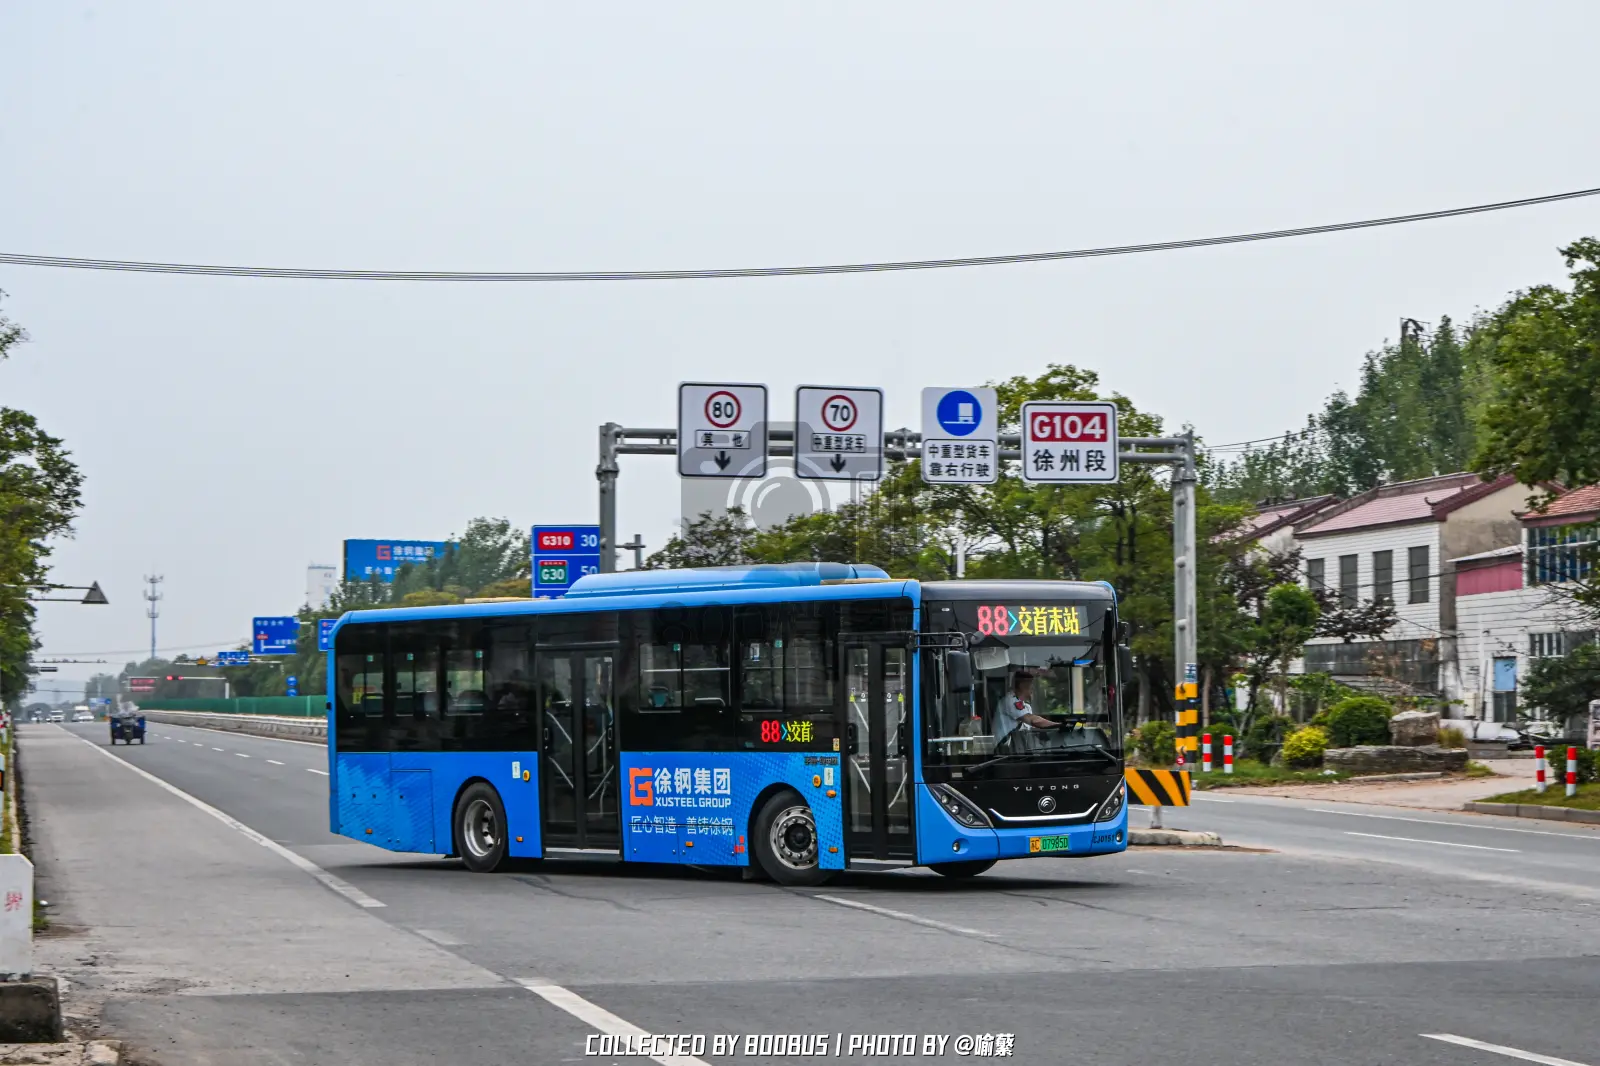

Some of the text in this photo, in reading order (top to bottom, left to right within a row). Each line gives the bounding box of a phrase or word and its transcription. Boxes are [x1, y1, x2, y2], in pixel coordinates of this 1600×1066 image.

[712, 401, 734, 419] 80
[830, 405, 851, 423] 70
[1033, 416, 1106, 440] G104
[812, 435, 865, 452] 中重型货车
[928, 444, 989, 459] 中重型货车
[929, 462, 990, 478] 靠右行驶
[1032, 449, 1107, 473] 徐州段
[542, 534, 598, 547] G310 30
[541, 568, 565, 580] G30
[977, 605, 1009, 636] 88
[1018, 606, 1080, 635] 交首末站
[761, 720, 781, 743] 88
[654, 767, 731, 796] 徐钢集团
[655, 797, 731, 808] XUSTEEL GROUP
